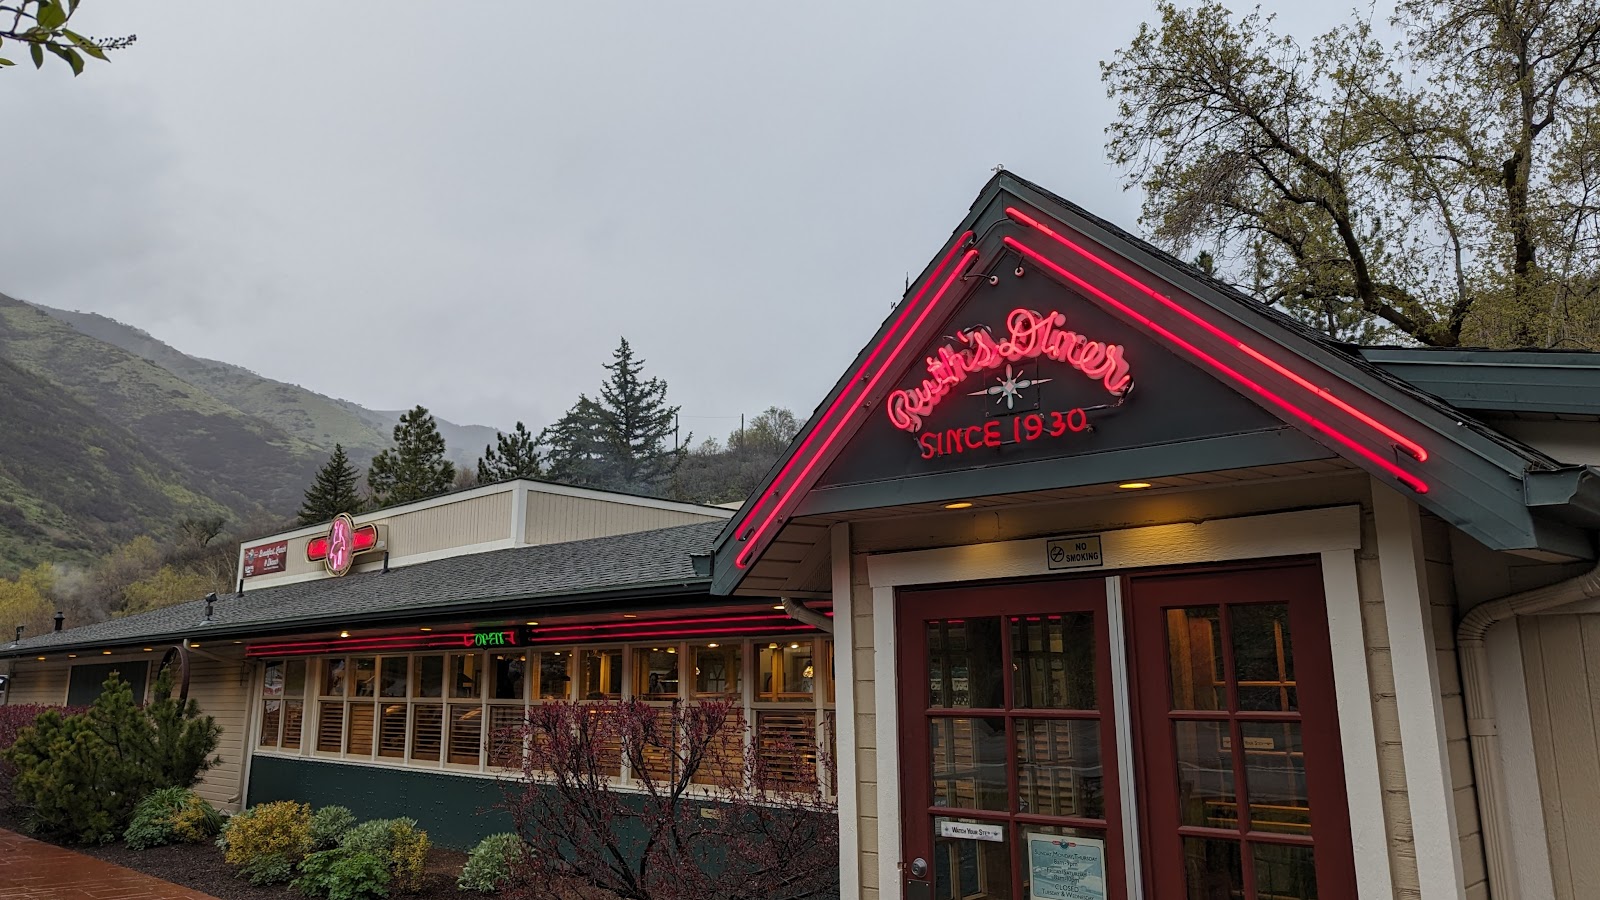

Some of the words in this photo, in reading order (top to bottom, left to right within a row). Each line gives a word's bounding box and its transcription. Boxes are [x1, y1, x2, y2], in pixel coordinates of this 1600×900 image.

[887, 330, 1000, 431] Ruth's
[998, 308, 1134, 395] Diner
[919, 420, 1001, 459] SINCE
[1013, 408, 1087, 443] 1930
[1075, 542, 1087, 551] NO
[1065, 552, 1098, 562] SMOKING
[475, 632, 504, 646] OPEN
[1054, 883, 1079, 893] CLOSED
